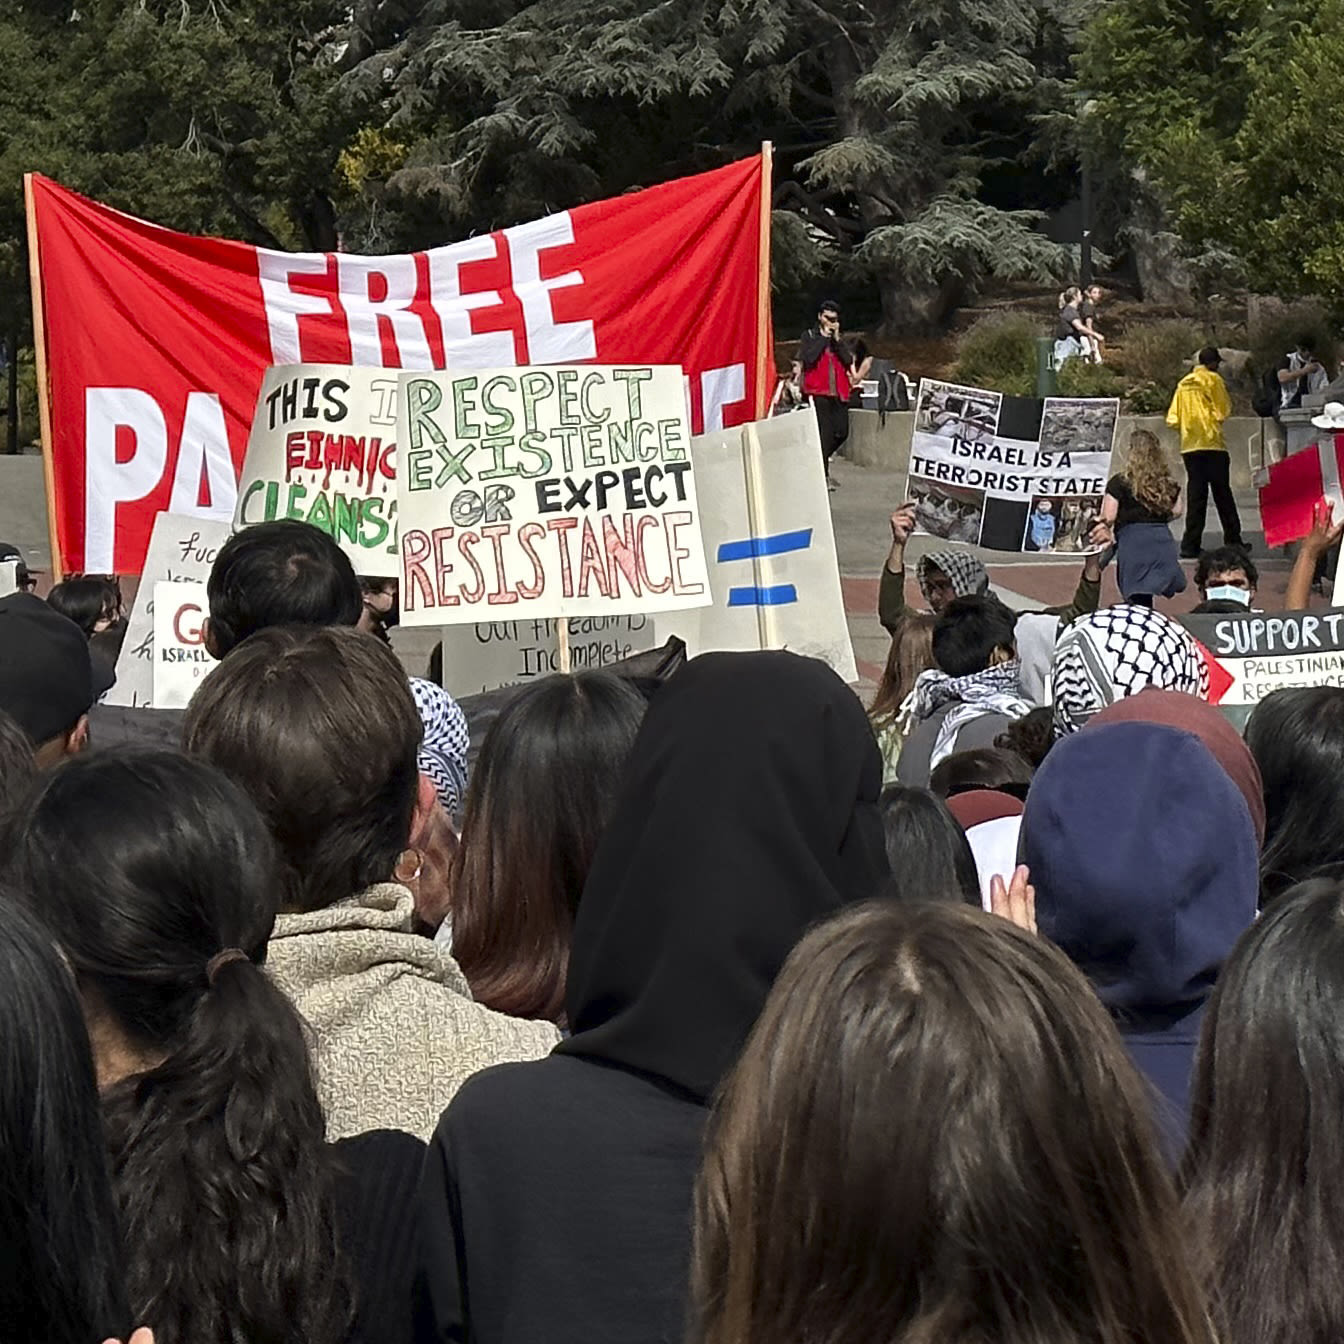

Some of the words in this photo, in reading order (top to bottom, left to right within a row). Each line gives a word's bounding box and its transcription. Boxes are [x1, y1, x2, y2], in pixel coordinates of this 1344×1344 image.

[256, 209, 598, 371] FREE
[265, 377, 351, 431] THIS
[407, 368, 652, 448] RESPECT
[408, 418, 687, 492] EXISTENCE
[912, 455, 1034, 494] TERRORIST
[1038, 477, 1105, 495] STATE
[950, 434, 1027, 467] ISRAEL
[1033, 452, 1052, 468] IS
[1057, 452, 1072, 469] A
[450, 484, 516, 527] OR
[535, 461, 692, 514] EXPECT
[402, 510, 705, 612] RESISTANCE
[1214, 613, 1344, 654] SUPPORT
